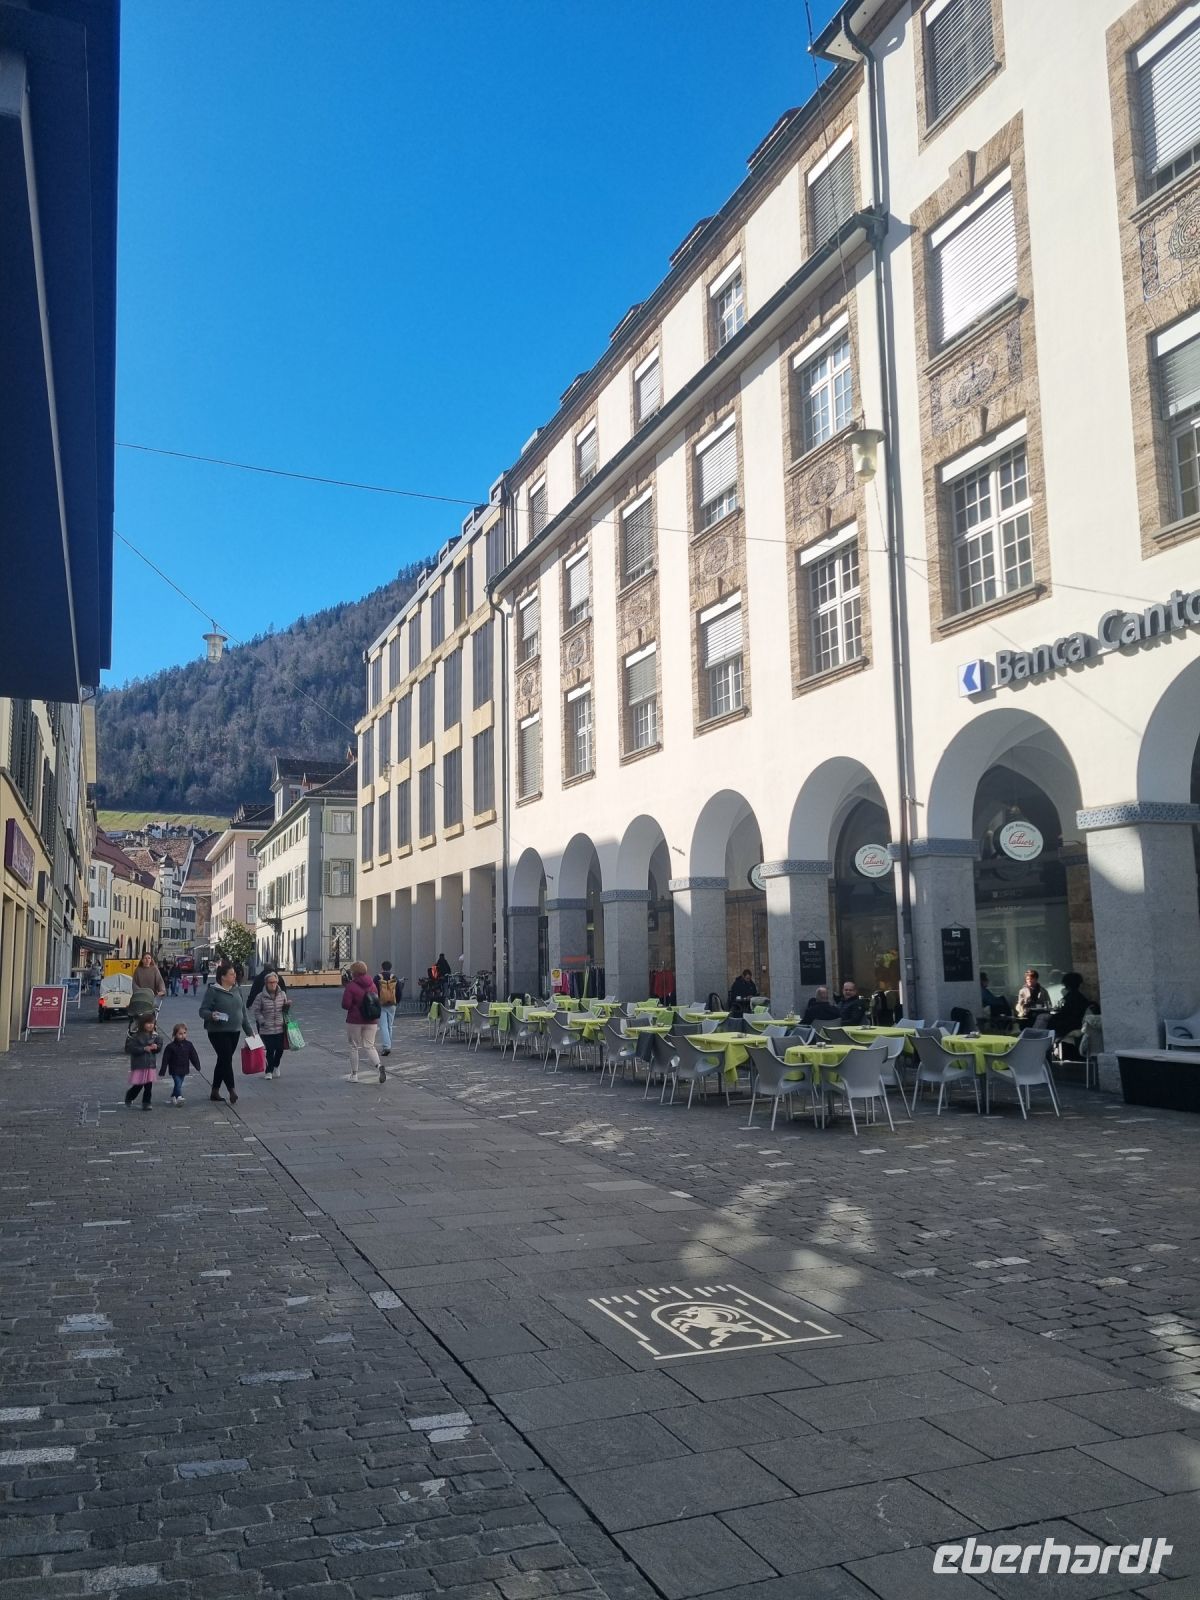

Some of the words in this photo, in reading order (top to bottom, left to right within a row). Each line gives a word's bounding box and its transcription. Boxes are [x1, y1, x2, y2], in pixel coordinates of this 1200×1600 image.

[996, 632, 1088, 685] Banca
[1098, 590, 1200, 649] Canto
[35, 996, 59, 1006] 2=3
